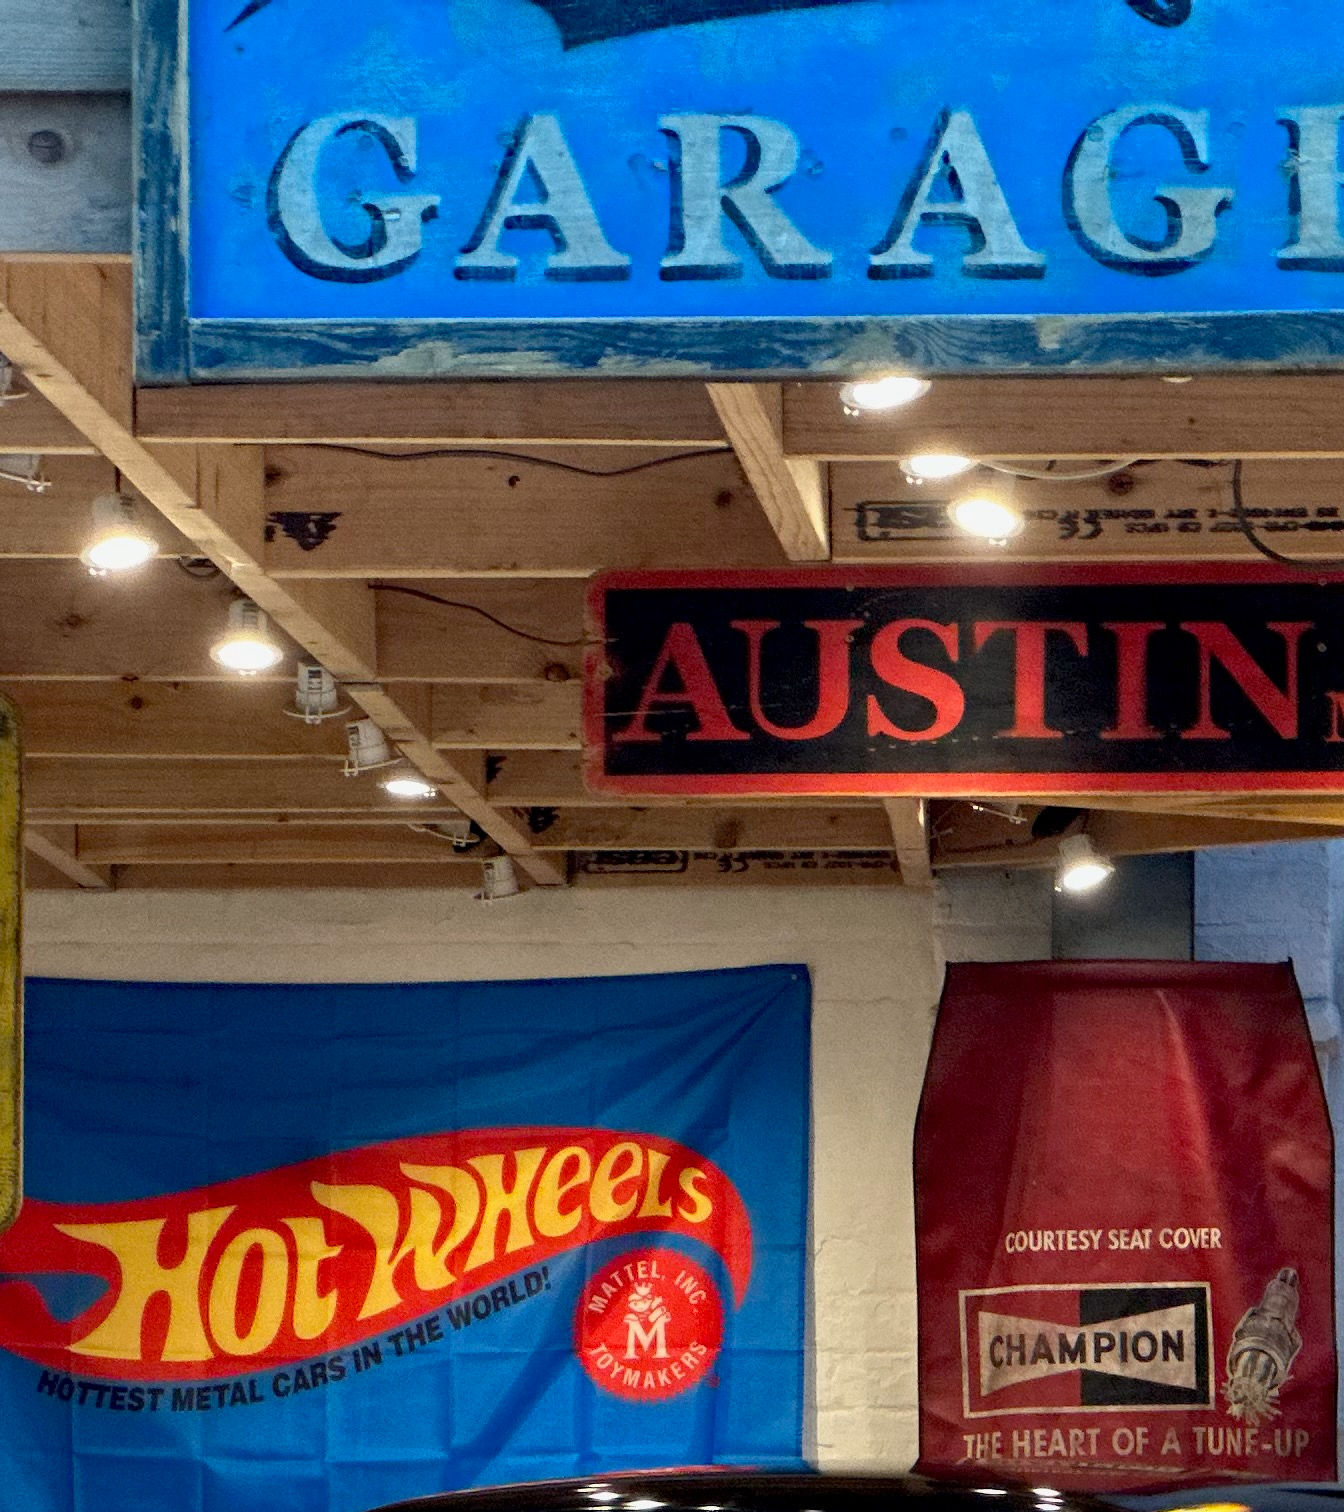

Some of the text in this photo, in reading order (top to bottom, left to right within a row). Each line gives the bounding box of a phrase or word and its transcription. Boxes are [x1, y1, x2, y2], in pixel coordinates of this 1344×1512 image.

[612, 618, 1316, 743] AUSTIN
[1005, 1227, 1223, 1254] COURTESY SEAT COVER
[37, 1265, 552, 1412] HOTTEST METAL CARS IN THE WORLD!
[623, 1313, 672, 1360] M
[989, 1328, 1186, 1369] CHAMPION
[589, 1340, 708, 1389] TOYMAKERS
[963, 1427, 1311, 1460] THE HEART OF A TUNE-UP
